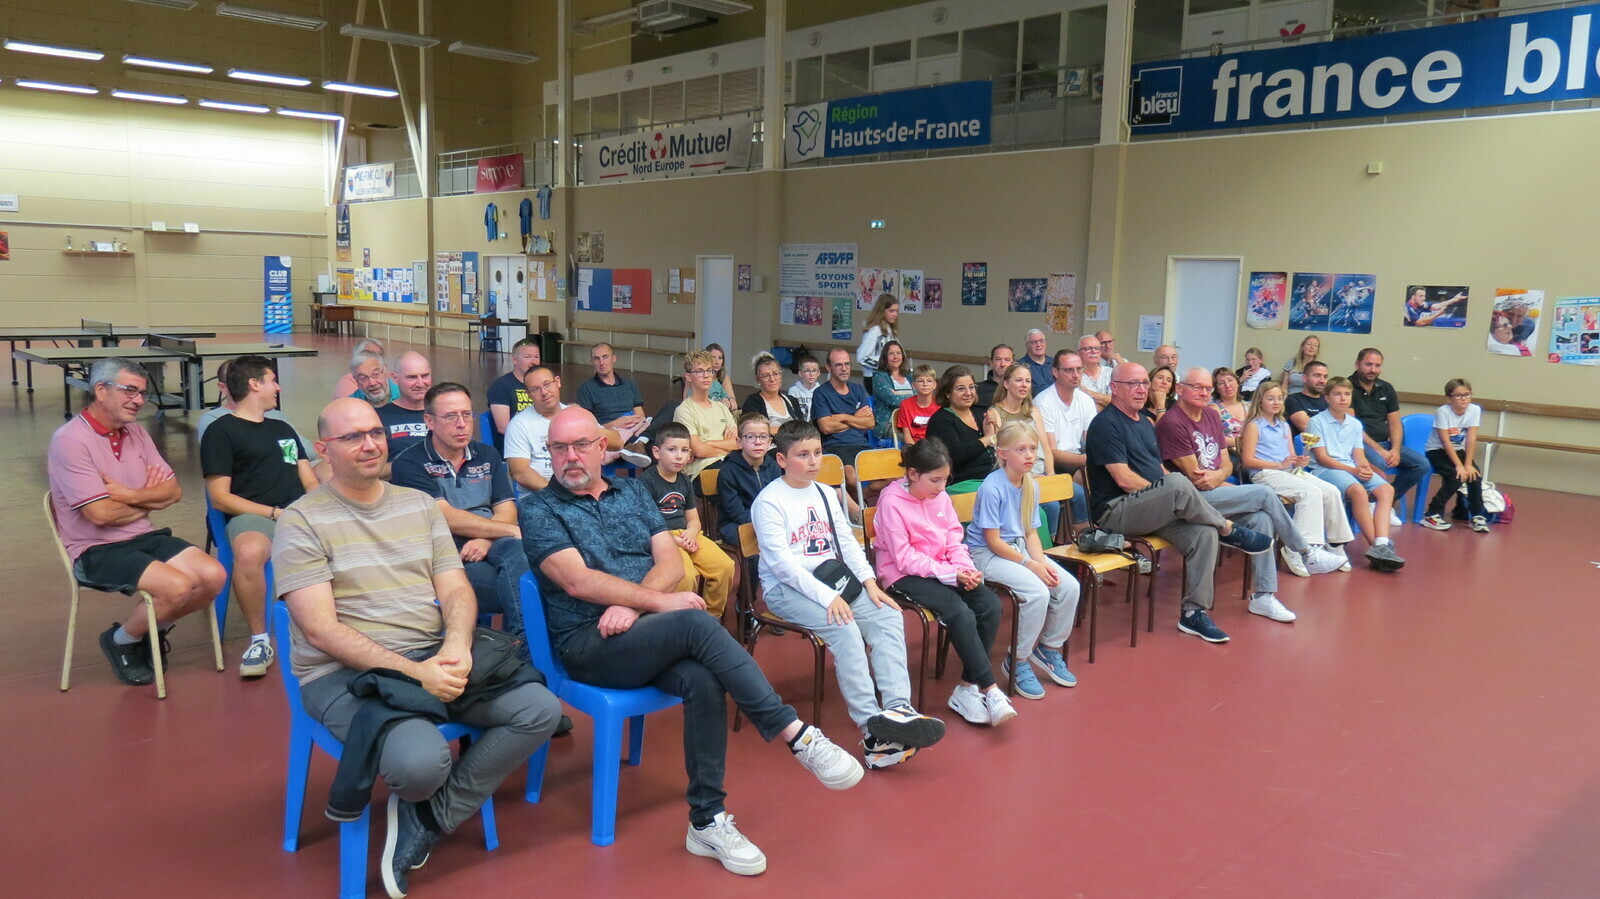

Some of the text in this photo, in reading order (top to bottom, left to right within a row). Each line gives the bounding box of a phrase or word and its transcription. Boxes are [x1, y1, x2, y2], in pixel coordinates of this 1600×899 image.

[1212, 14, 1600, 122] france bl
[1140, 95, 1178, 115] bleu
[1155, 91, 1178, 99] france
[831, 104, 878, 124] Région
[830, 119, 981, 149] Hauts-de-France
[599, 127, 732, 168] Crédit Mutuel
[632, 160, 685, 175] Nord Europe
[815, 252, 854, 265] AFSVFP
[815, 273, 855, 281] SOYONS
[791, 520, 834, 546] ARIZON
